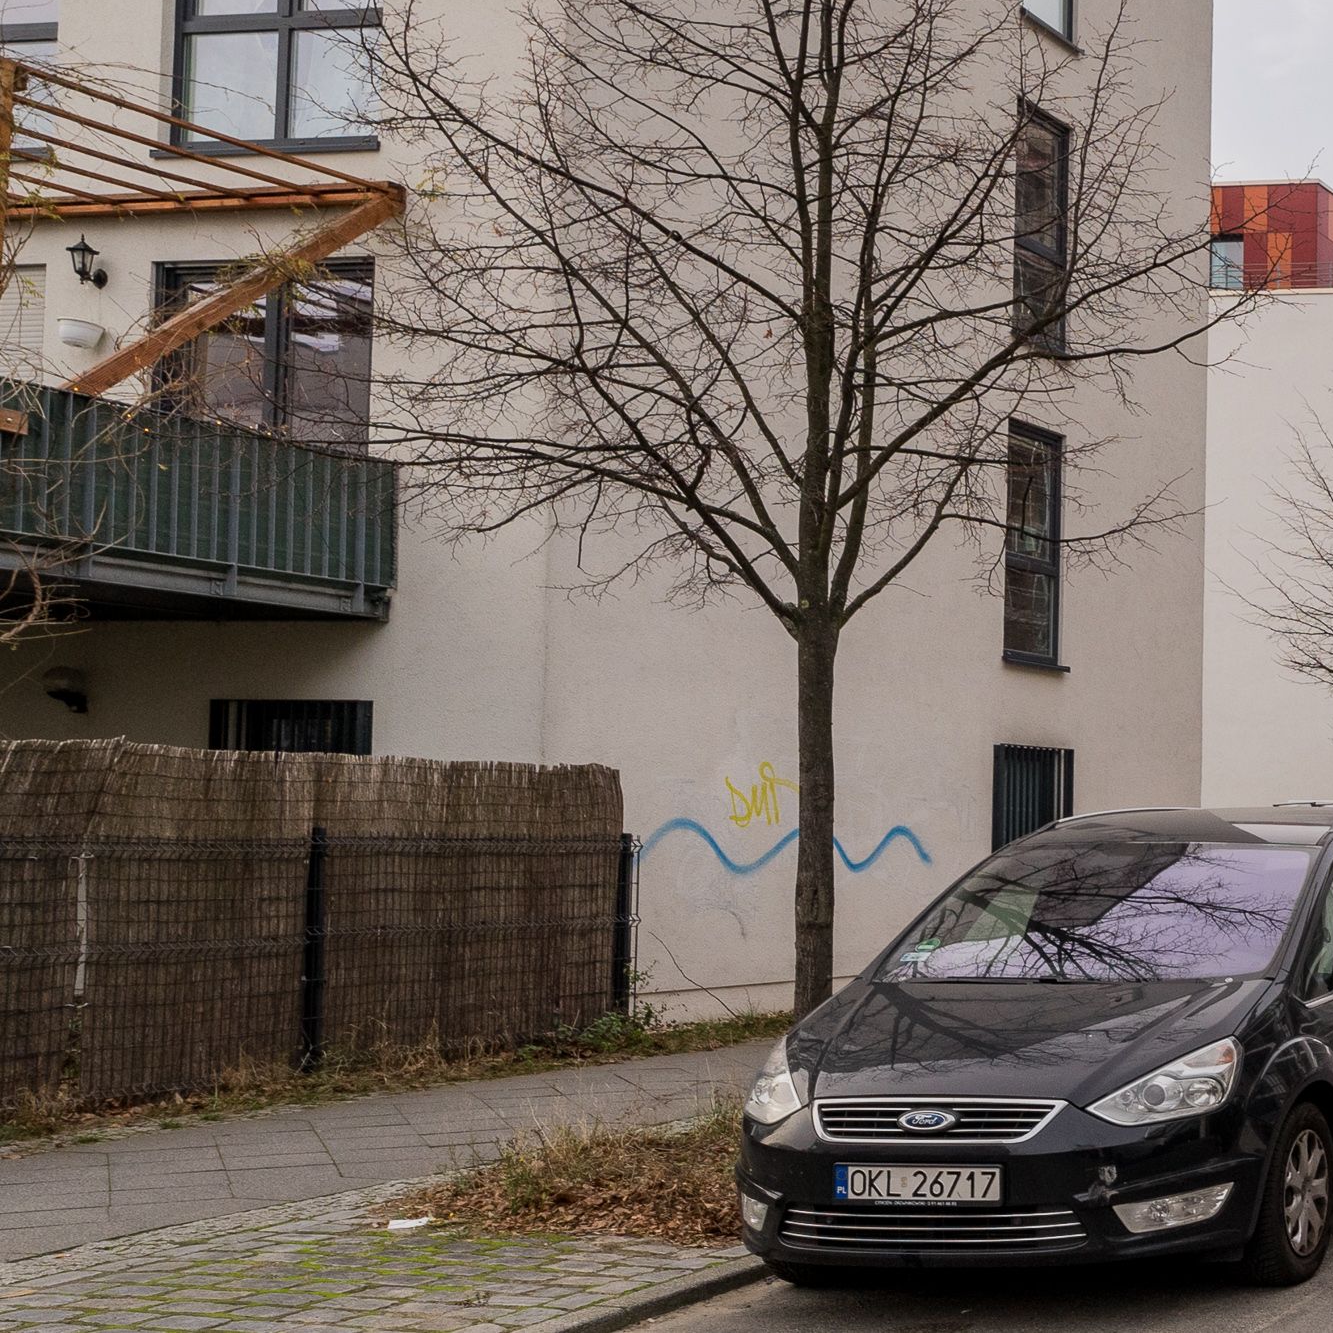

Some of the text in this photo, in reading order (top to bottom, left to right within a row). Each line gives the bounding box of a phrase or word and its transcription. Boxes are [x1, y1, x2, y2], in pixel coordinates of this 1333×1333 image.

[912, 1114, 938, 1125] Ford
[850, 1169, 997, 1199] OKL 26717
[837, 1186, 847, 1194] PL
